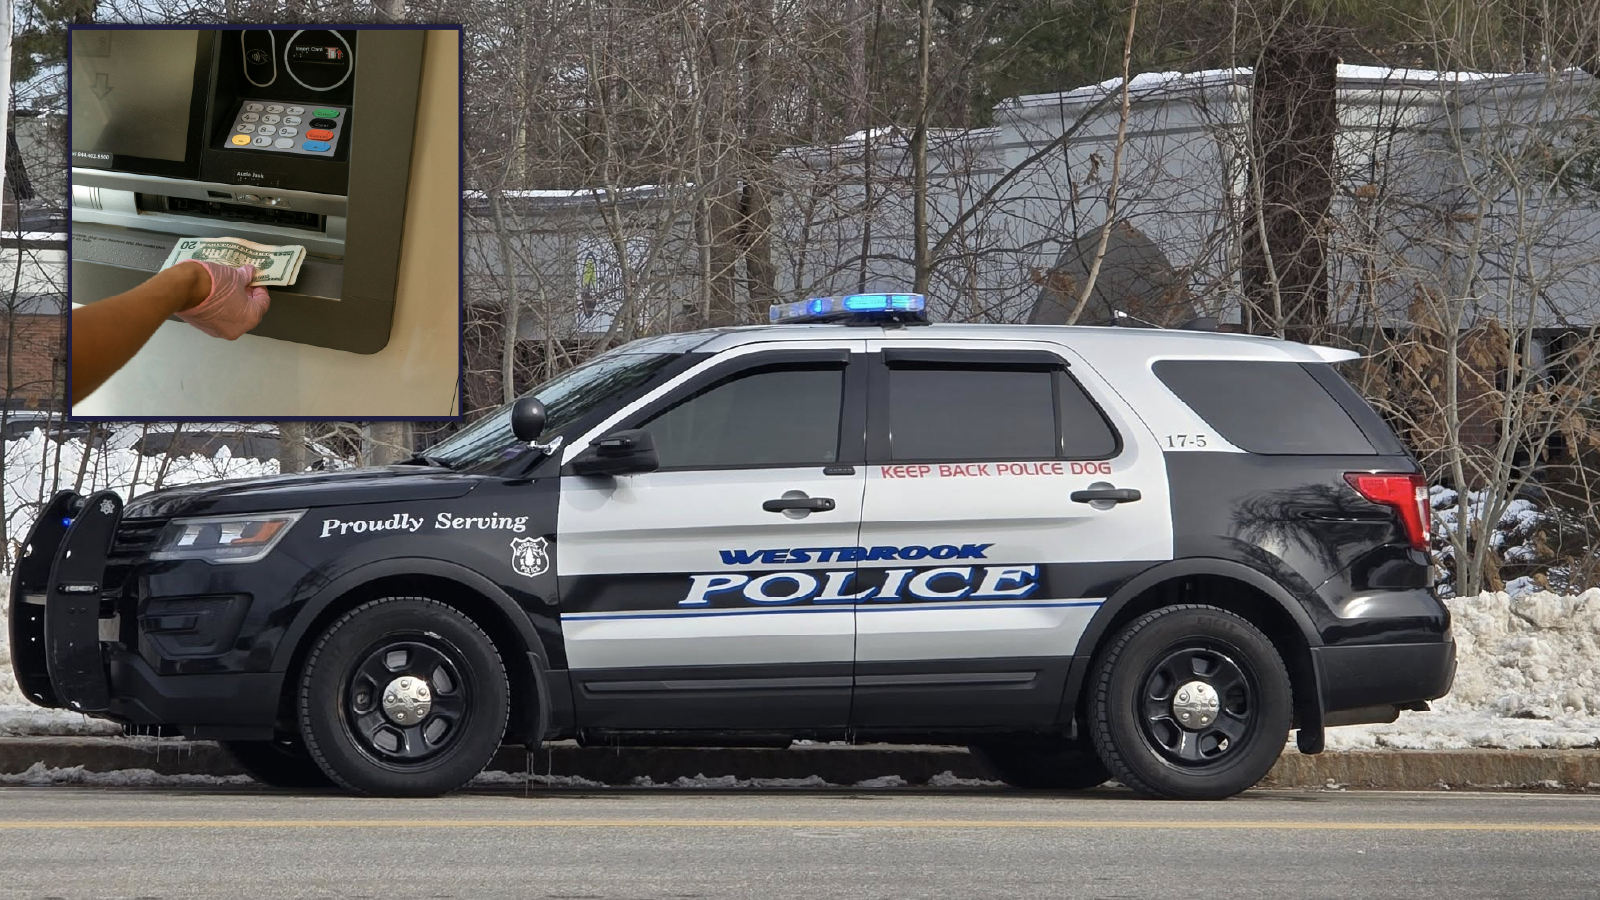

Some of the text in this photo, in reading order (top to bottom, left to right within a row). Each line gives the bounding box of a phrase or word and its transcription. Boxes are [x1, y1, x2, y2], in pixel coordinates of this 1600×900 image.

[180, 241, 198, 250] 20
[1165, 434, 1207, 448] 17-5
[881, 462, 1112, 479] KEEP BACK POLICE DOG
[319, 512, 529, 538] Proudly Serving
[718, 543, 997, 565] WESTBROOK
[678, 565, 1041, 608] POLICE
